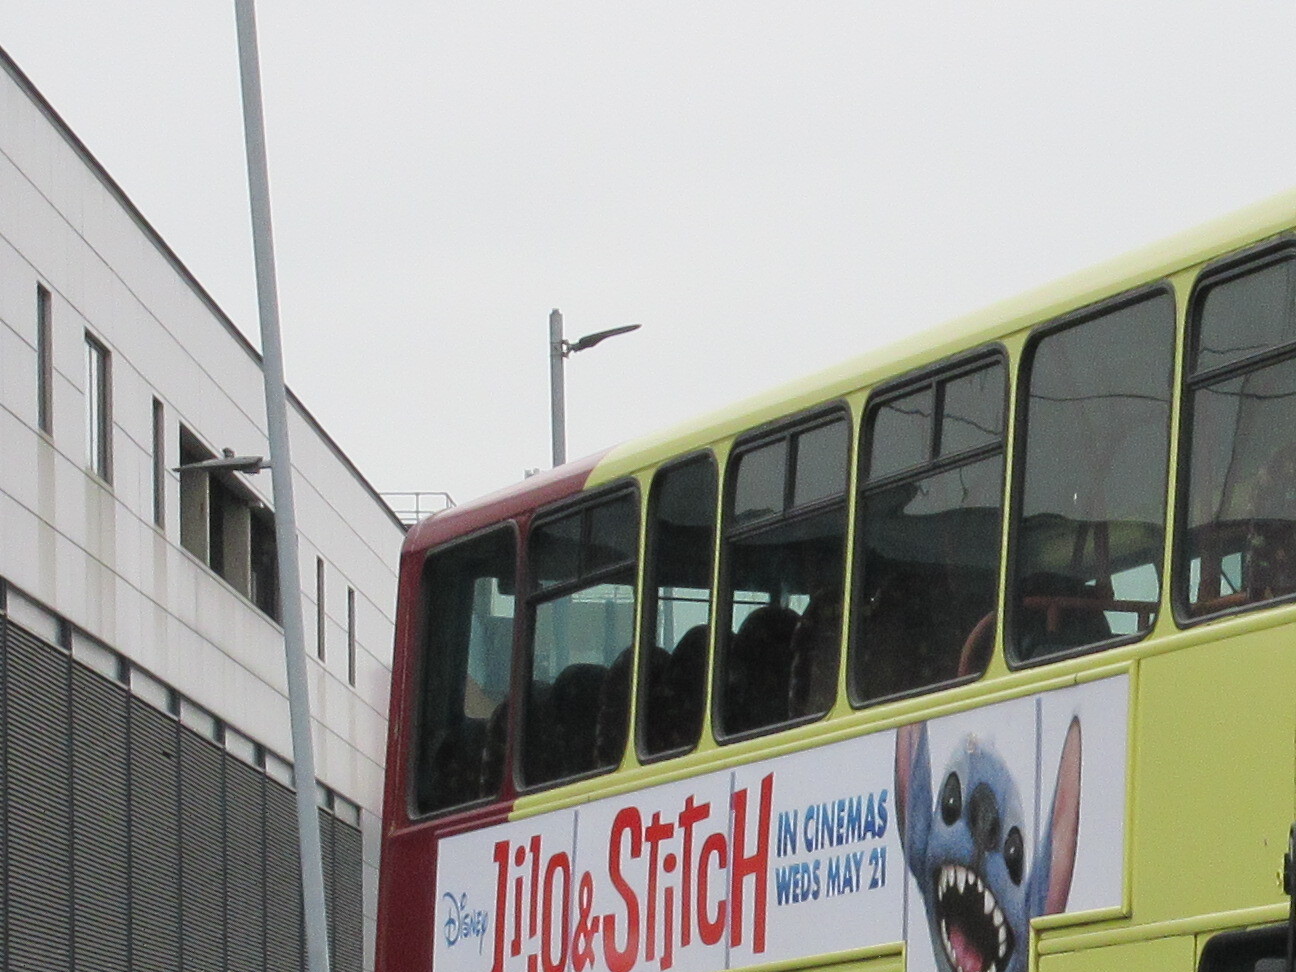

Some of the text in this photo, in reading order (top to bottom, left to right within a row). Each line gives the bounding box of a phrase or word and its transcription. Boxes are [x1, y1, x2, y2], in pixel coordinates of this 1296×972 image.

[777, 789, 888, 857] IN CINEMAS
[776, 846, 888, 906] WEDS MAY 21
